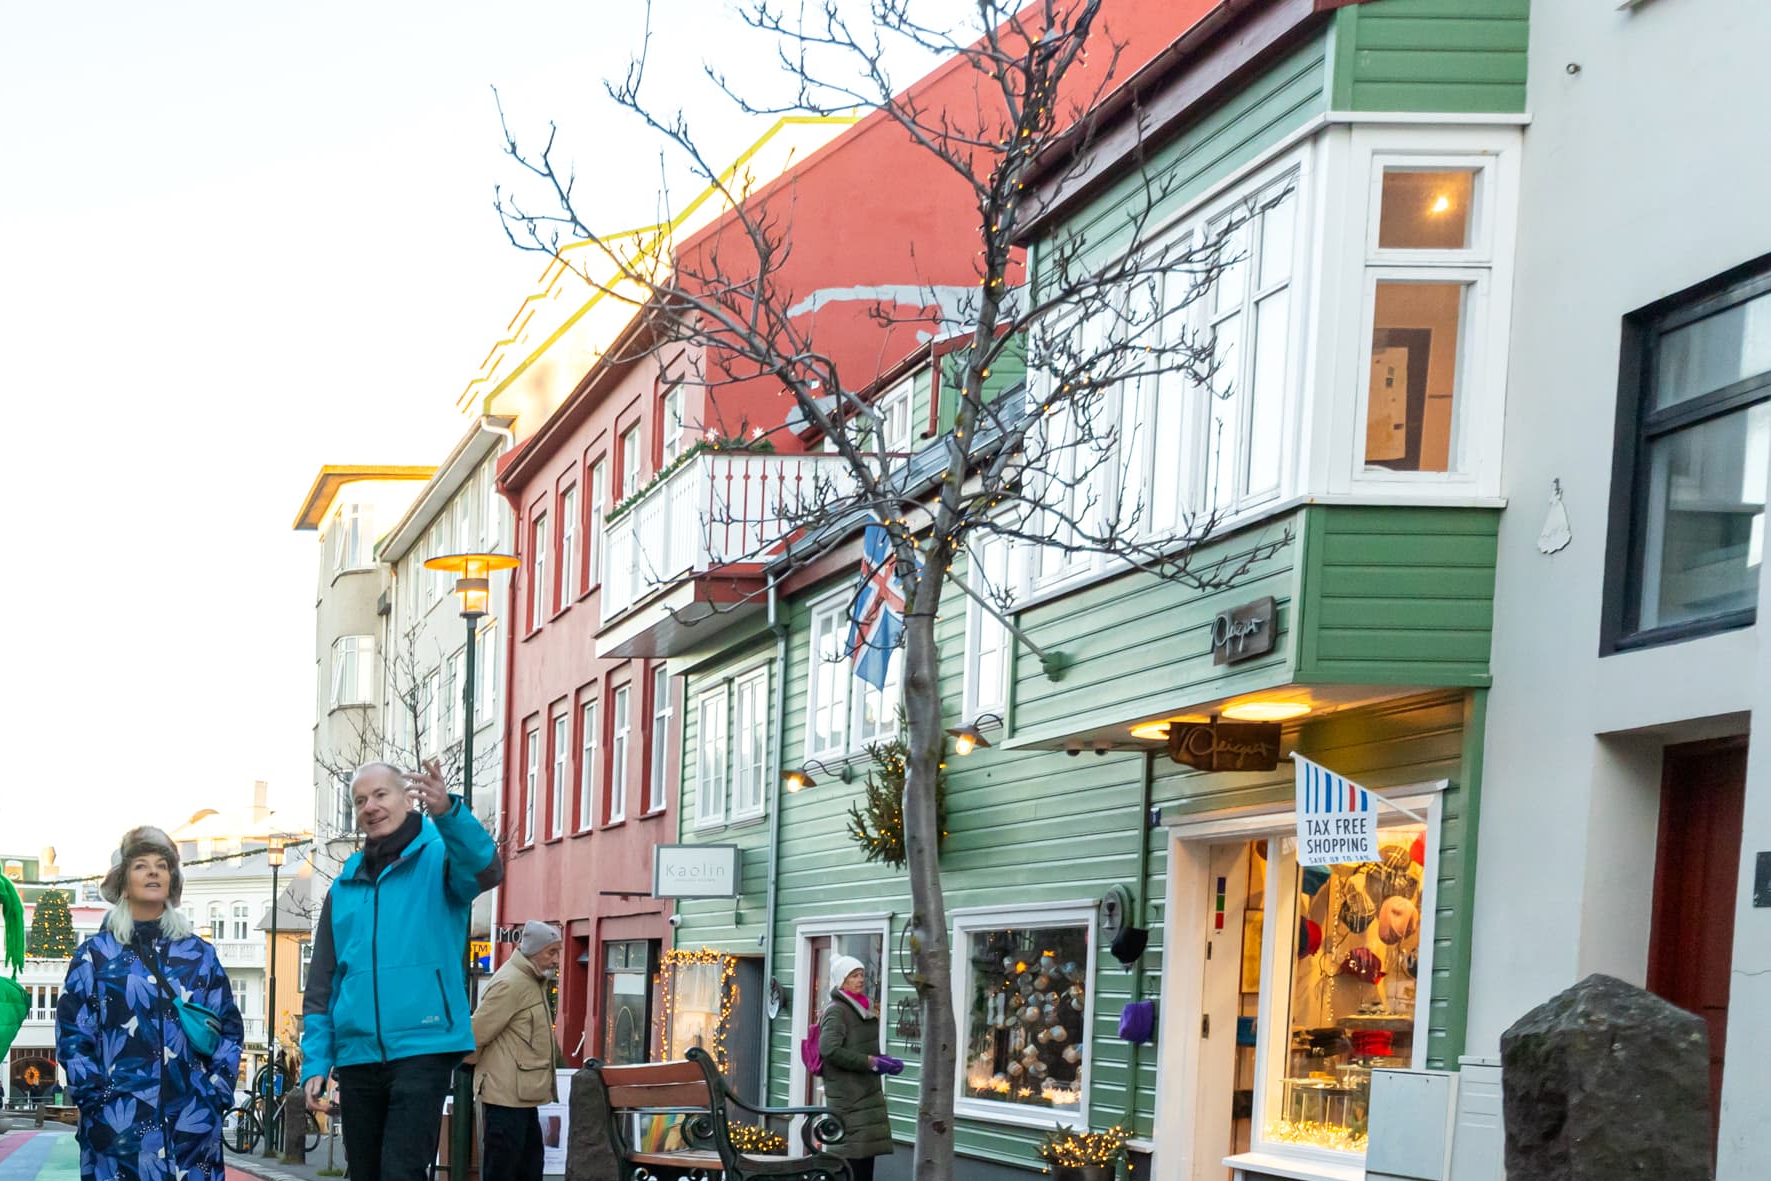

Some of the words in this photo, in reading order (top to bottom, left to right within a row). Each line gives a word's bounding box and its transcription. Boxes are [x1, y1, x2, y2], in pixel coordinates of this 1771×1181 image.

[1306, 820, 1330, 836] TAX
[1336, 818, 1367, 835] FREE
[1307, 838, 1368, 854] SHOPPING
[666, 863, 725, 877] Kaolin
[472, 944, 488, 953] TM
